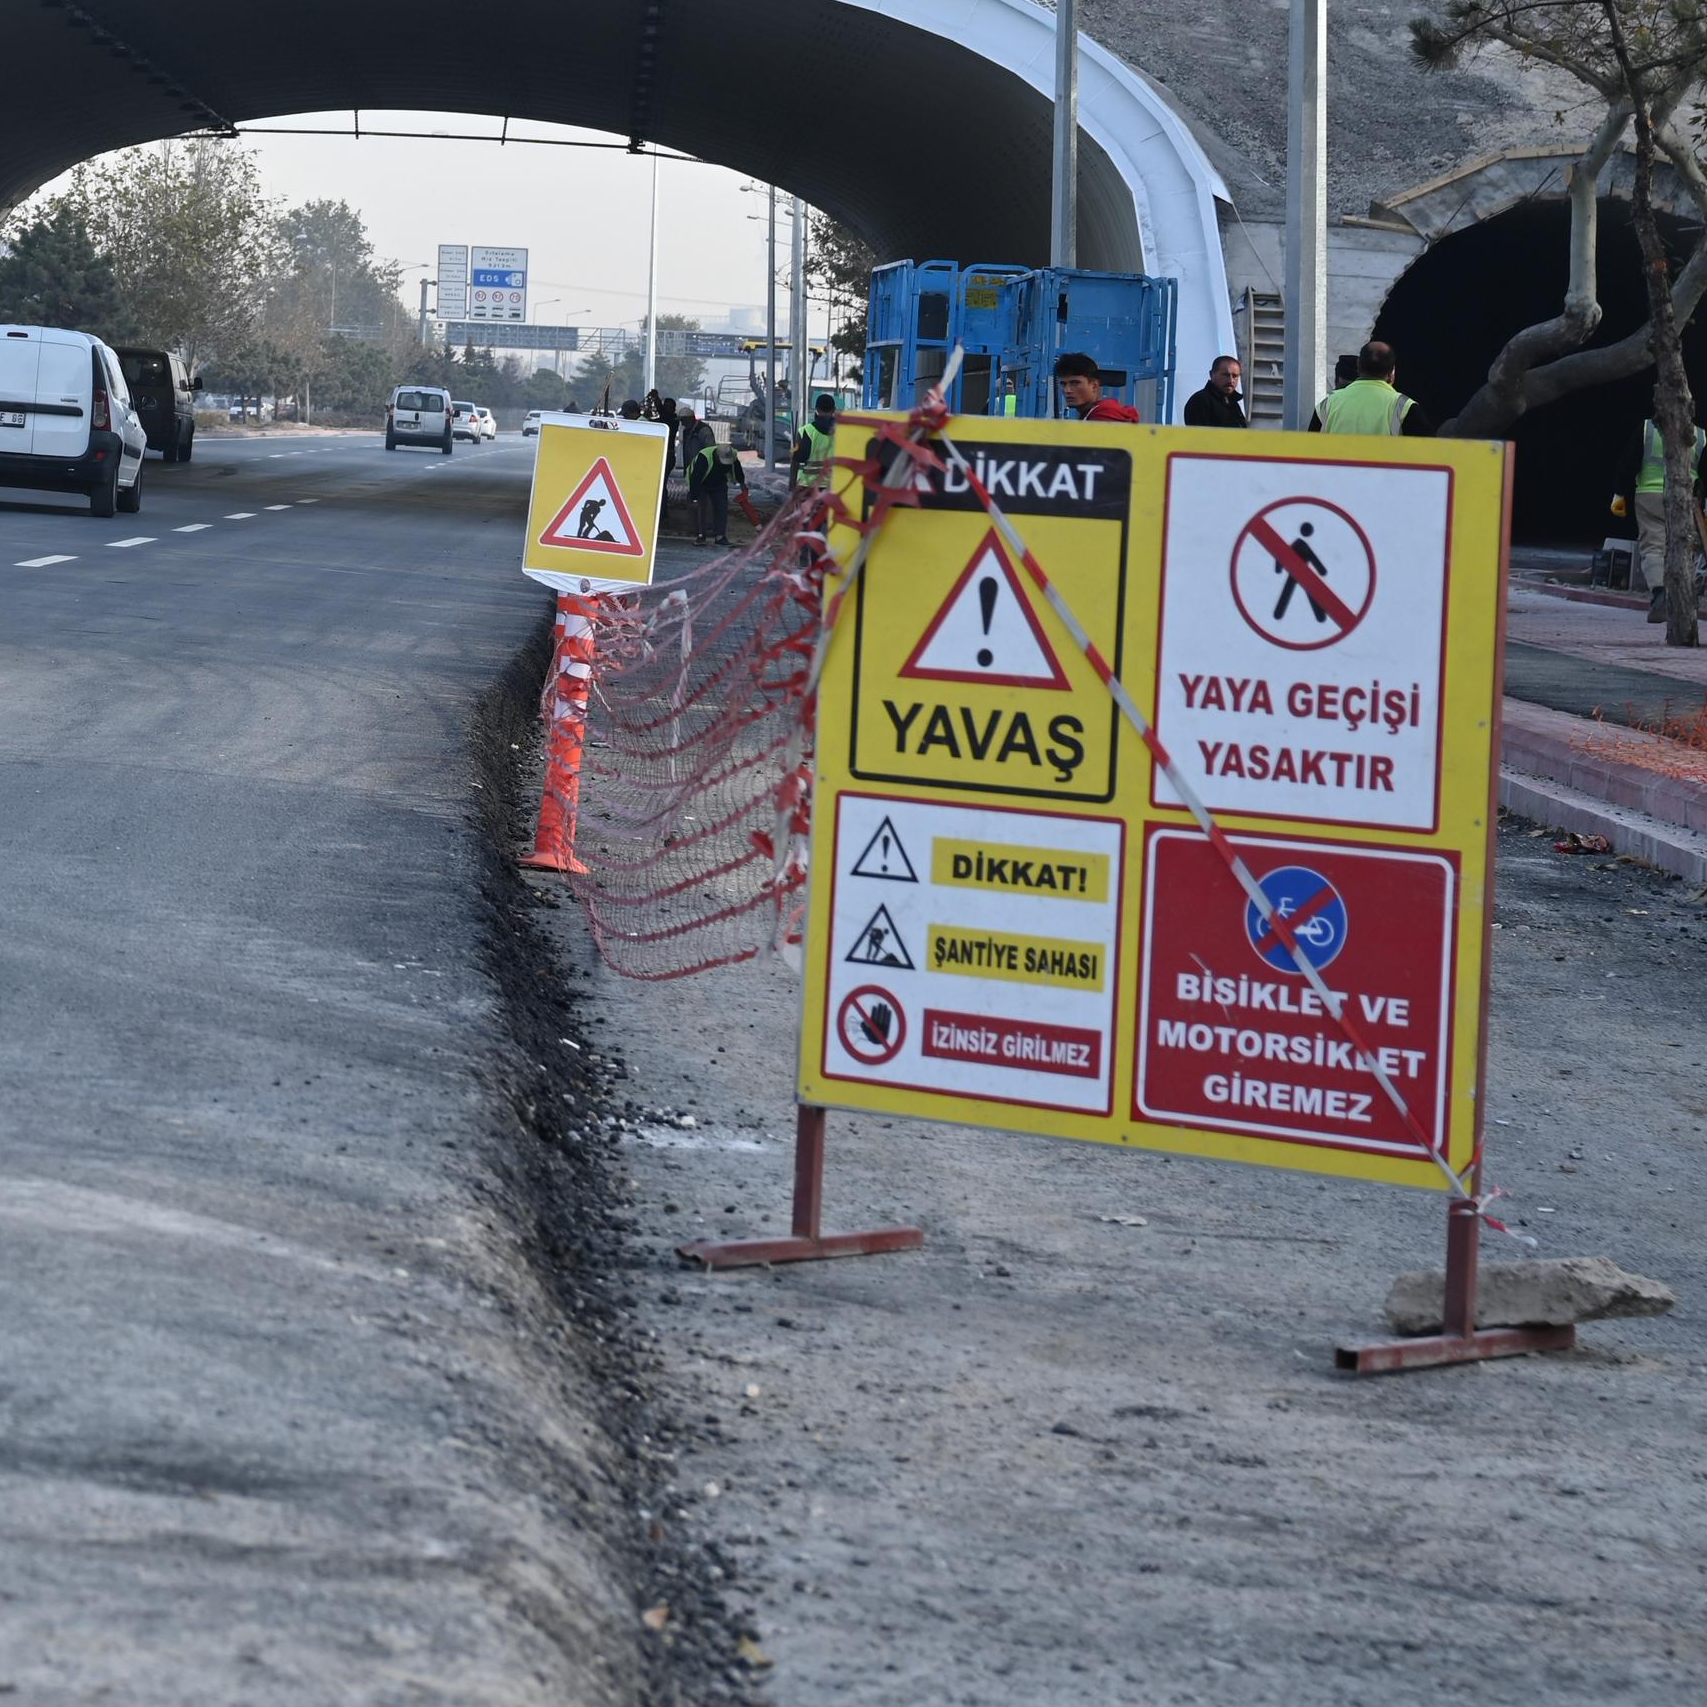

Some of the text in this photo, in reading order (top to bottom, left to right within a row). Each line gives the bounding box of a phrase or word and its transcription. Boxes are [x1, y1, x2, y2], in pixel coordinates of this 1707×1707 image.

[479, 274, 500, 283] EDS
[944, 451, 1104, 500] DİKKAT
[1178, 673, 1421, 735] YAYA GEÇİŞİ
[882, 699, 1085, 783] YAVAŞ
[1197, 740, 1395, 792] YASAKTIR
[952, 851, 1088, 893] DİKKAT!
[934, 937, 1098, 980] ŞANTİYE SAHASI
[1177, 969, 1410, 1027] BİSİKLET VE
[932, 1021, 1090, 1068] İZİNSİZ GİRİLMEZ
[1203, 1071, 1374, 1123] GİREMEZ
